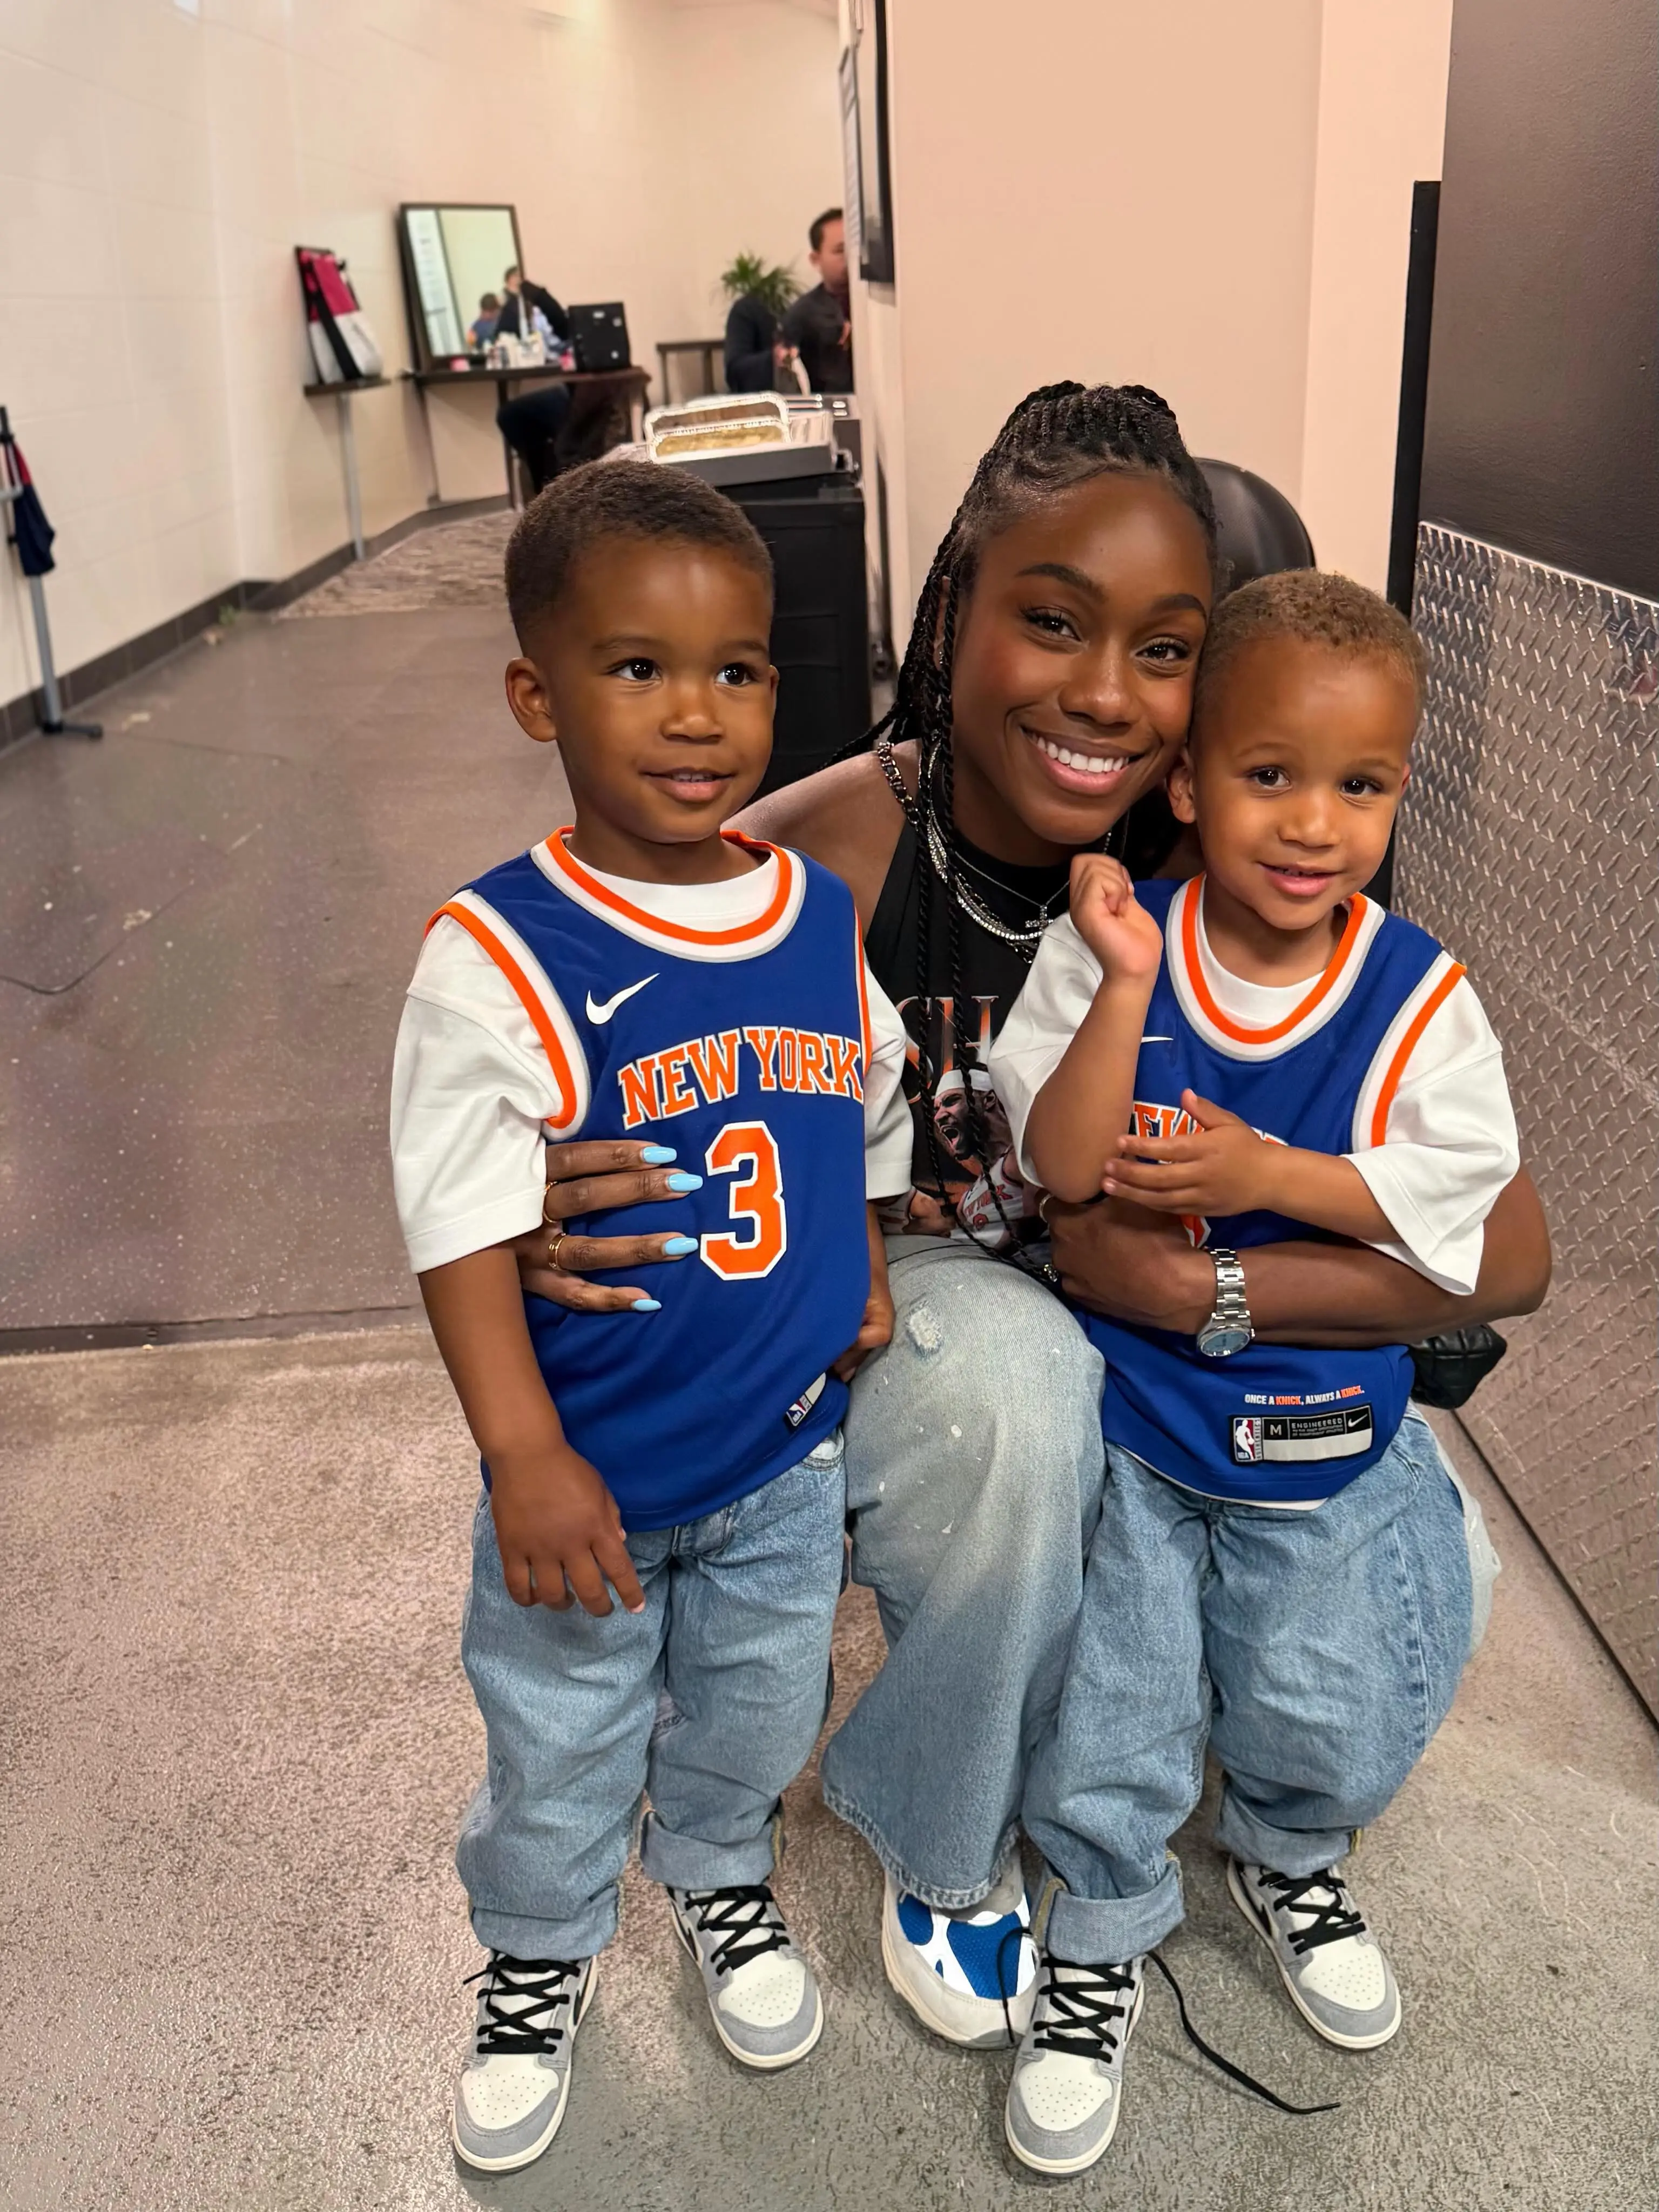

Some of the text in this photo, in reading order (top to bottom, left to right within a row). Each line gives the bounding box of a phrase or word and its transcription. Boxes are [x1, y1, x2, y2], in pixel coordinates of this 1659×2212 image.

[617, 1026, 864, 1130] NEW YORK
[700, 1121, 787, 1281] 3
[1244, 1394, 1267, 1404] ONCE
[1268, 1396, 1275, 1405] A
[1305, 1392, 1334, 1405] ALWAYS
[1336, 1390, 1341, 1399] A
[1270, 1424, 1282, 1436] M
[1291, 1418, 1343, 1429] ENGINEERED
